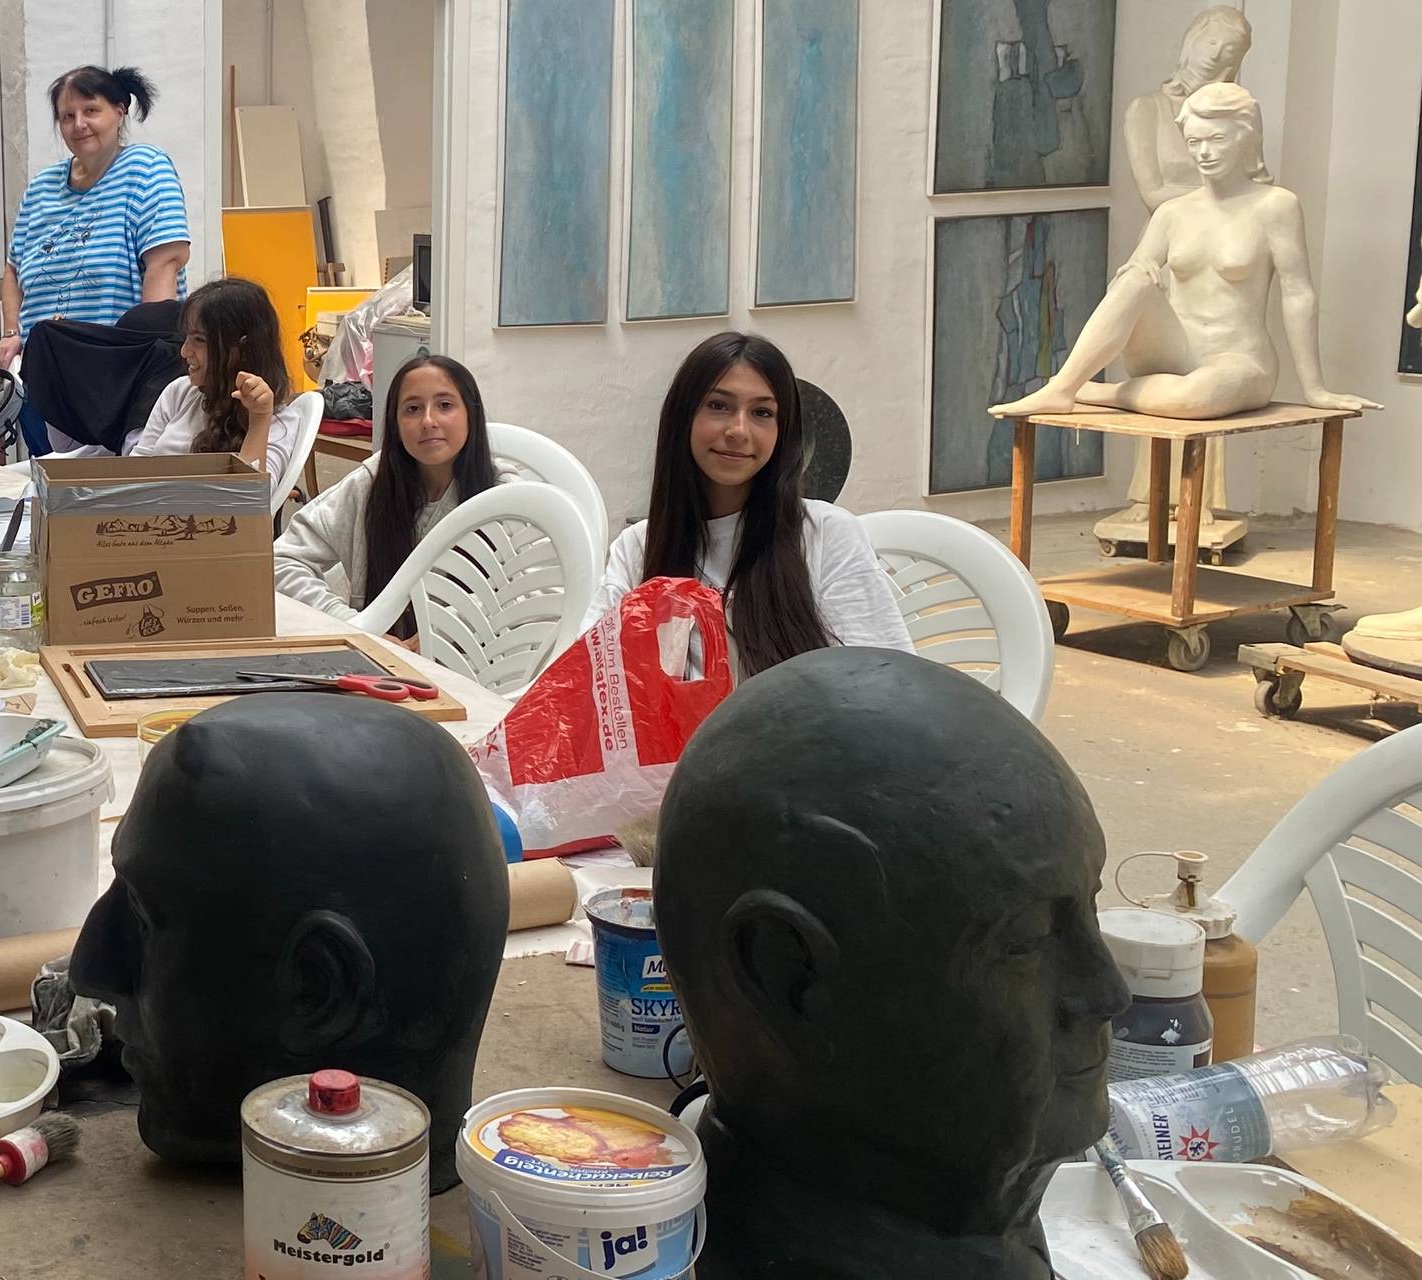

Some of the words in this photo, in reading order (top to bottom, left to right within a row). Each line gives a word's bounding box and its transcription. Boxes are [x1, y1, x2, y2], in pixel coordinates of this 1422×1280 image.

[76, 578, 154, 605] GEFRO
[176, 615, 206, 624] Würzen
[207, 615, 222, 623] und
[223, 614, 243, 623] mehr
[609, 673, 628, 750] Bestellen
[503, 1155, 674, 1180] Reibekuchenteig
[273, 1238, 384, 1267] Meistergold
[600, 1225, 649, 1271] ja!
